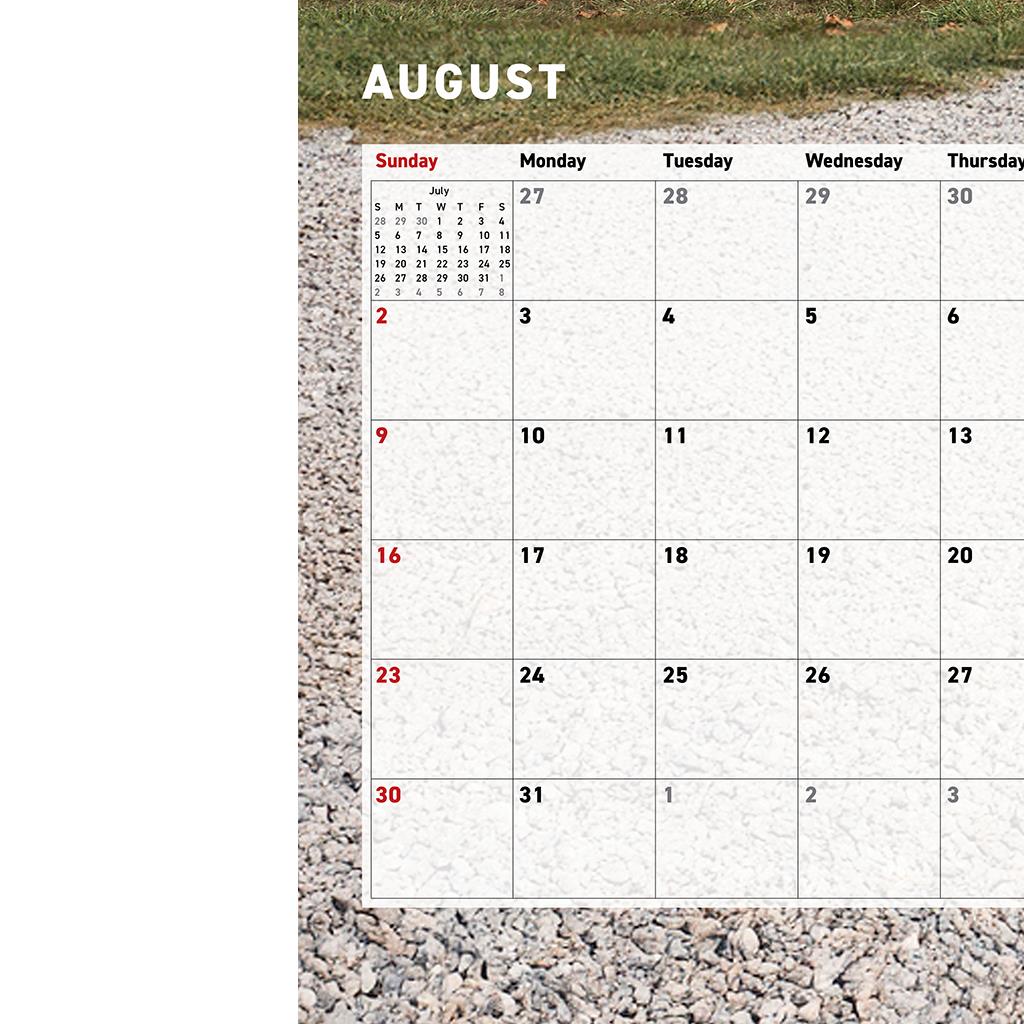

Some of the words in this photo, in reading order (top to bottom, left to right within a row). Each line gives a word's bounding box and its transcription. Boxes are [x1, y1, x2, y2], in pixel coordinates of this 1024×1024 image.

[361, 64, 565, 100] AUGUST
[376, 153, 438, 171] Sunday
[521, 153, 586, 171] Monday
[663, 153, 733, 171] Tuesday
[806, 153, 903, 171] Wednesday
[429, 187, 449, 197] July
[520, 188, 544, 204] 27
[664, 188, 687, 204] 28
[806, 188, 830, 204] 29
[948, 188, 972, 204] 30
[375, 203, 381, 211] S
[395, 203, 403, 211] M
[416, 203, 422, 211] T
[436, 203, 446, 211] W
[457, 203, 463, 211] T
[479, 203, 484, 211] F
[499, 203, 505, 211] S
[375, 217, 385, 225] 28
[396, 217, 406, 225] 29
[417, 217, 427, 225] 30
[458, 217, 463, 225] 2
[479, 217, 484, 225] 3
[499, 217, 504, 225] 4
[376, 307, 387, 324] 2
[520, 307, 531, 324] 3
[662, 308, 675, 324] 4
[806, 307, 817, 324] 5
[948, 307, 959, 324] 6
[376, 427, 388, 443] 9
[522, 427, 544, 444] 10
[665, 427, 685, 443] 11
[807, 427, 829, 443] 12
[950, 427, 972, 444] 13
[378, 547, 401, 563] 16
[522, 547, 544, 563] 17
[665, 547, 688, 563] 18
[807, 547, 830, 563] 19
[948, 547, 972, 563] 20
[376, 666, 400, 683] 23
[520, 667, 545, 683] 24
[664, 666, 687, 683] 25
[806, 667, 830, 683] 26
[948, 667, 972, 683] 27
[376, 786, 401, 803] 30
[520, 786, 541, 803] 31
[665, 787, 671, 802] 1
[806, 786, 816, 802] 2
[948, 786, 958, 803] 3
